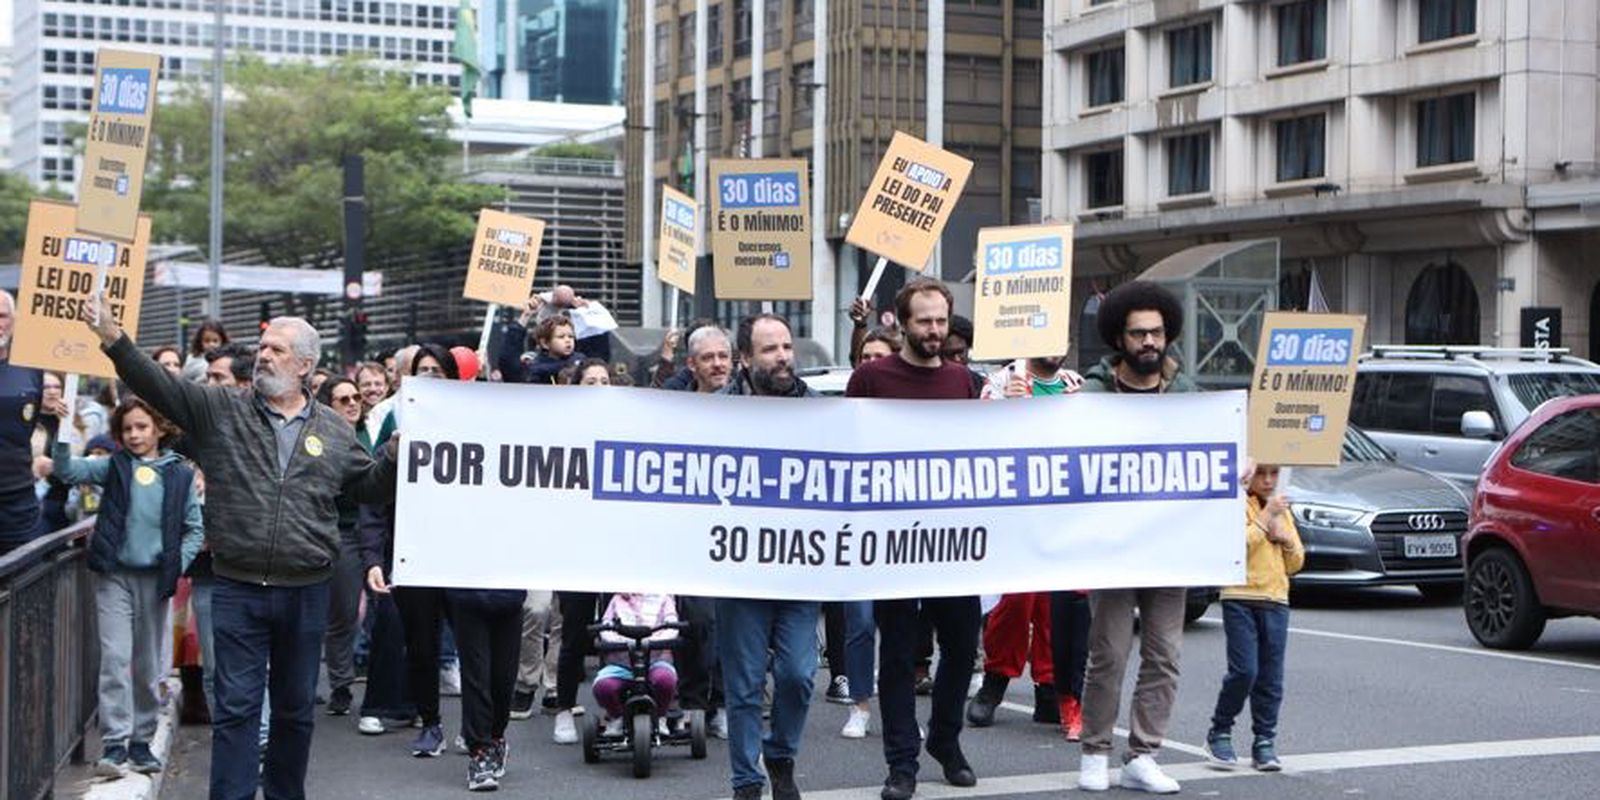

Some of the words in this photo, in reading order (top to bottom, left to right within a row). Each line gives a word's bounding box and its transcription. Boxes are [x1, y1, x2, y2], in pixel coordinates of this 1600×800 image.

[100, 74, 118, 107] 30
[118, 72, 147, 109] dias
[892, 157, 909, 174] EU
[908, 162, 942, 189] APOIO
[942, 178, 952, 193] A
[722, 178, 748, 204] 30
[754, 176, 796, 204] dias
[881, 176, 904, 197] LEI
[902, 184, 922, 204] DO
[920, 192, 944, 214] PAI
[718, 211, 726, 232] É
[730, 214, 740, 232] O
[744, 210, 804, 232] MÍNIMO!
[872, 194, 937, 233] PRESENTE!
[41, 236, 62, 257] EU
[66, 240, 116, 265] APOO
[119, 248, 130, 268] A
[481, 243, 496, 258] LEI
[498, 246, 512, 261] DO
[738, 241, 782, 252] Queremos
[988, 246, 1012, 270] 30
[1018, 242, 1060, 268] dias
[478, 257, 528, 278] PRESENTE!
[734, 256, 766, 266] mesmo
[36, 266, 64, 291] LEI
[68, 270, 93, 294] DO
[982, 277, 990, 296] É
[993, 280, 1002, 296] O
[1006, 275, 1064, 296] MÍNIMO!
[1270, 333, 1300, 360] 30
[1302, 333, 1349, 362] dias
[1534, 316, 1550, 355] STA
[1258, 368, 1268, 390] É
[1272, 372, 1282, 391] O
[1285, 370, 1349, 393] MÍNIMO!
[407, 440, 485, 486] POR
[500, 444, 591, 490] UMA
[601, 448, 1018, 506] LICENÇA-PATERNIDADE
[1026, 454, 1070, 498] DE
[1079, 449, 1230, 496] VERDADE
[708, 524, 748, 562] 30
[758, 527, 826, 566] DIAS
[834, 523, 852, 567] É
[860, 530, 877, 566] O
[885, 521, 988, 566] MÍNIMO
